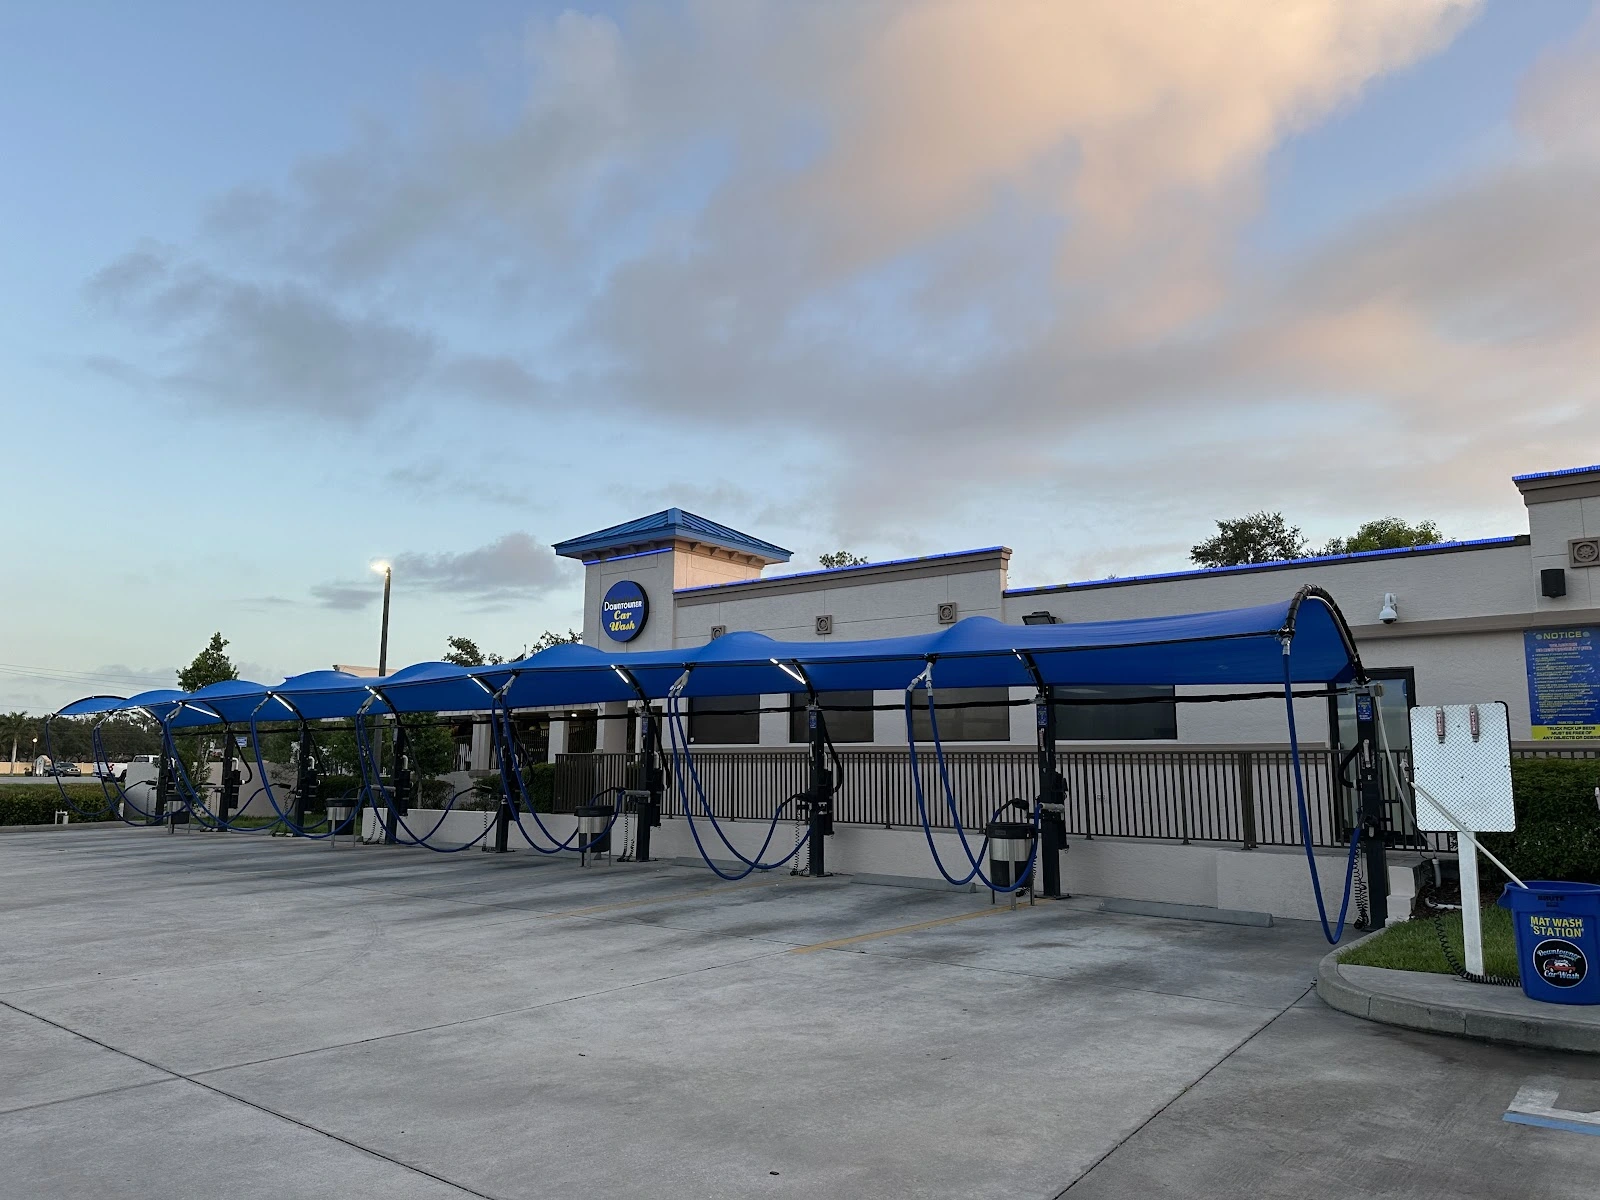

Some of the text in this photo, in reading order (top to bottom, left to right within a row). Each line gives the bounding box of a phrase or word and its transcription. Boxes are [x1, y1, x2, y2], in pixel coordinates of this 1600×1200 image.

[613, 610, 632, 620] Car
[609, 620, 635, 631] Wash
[1543, 631, 1582, 639] NOTICE
[1530, 916, 1583, 927] MAT WASH
[1533, 925, 1582, 937] STATION
[1544, 969, 1580, 980] Car Wash
